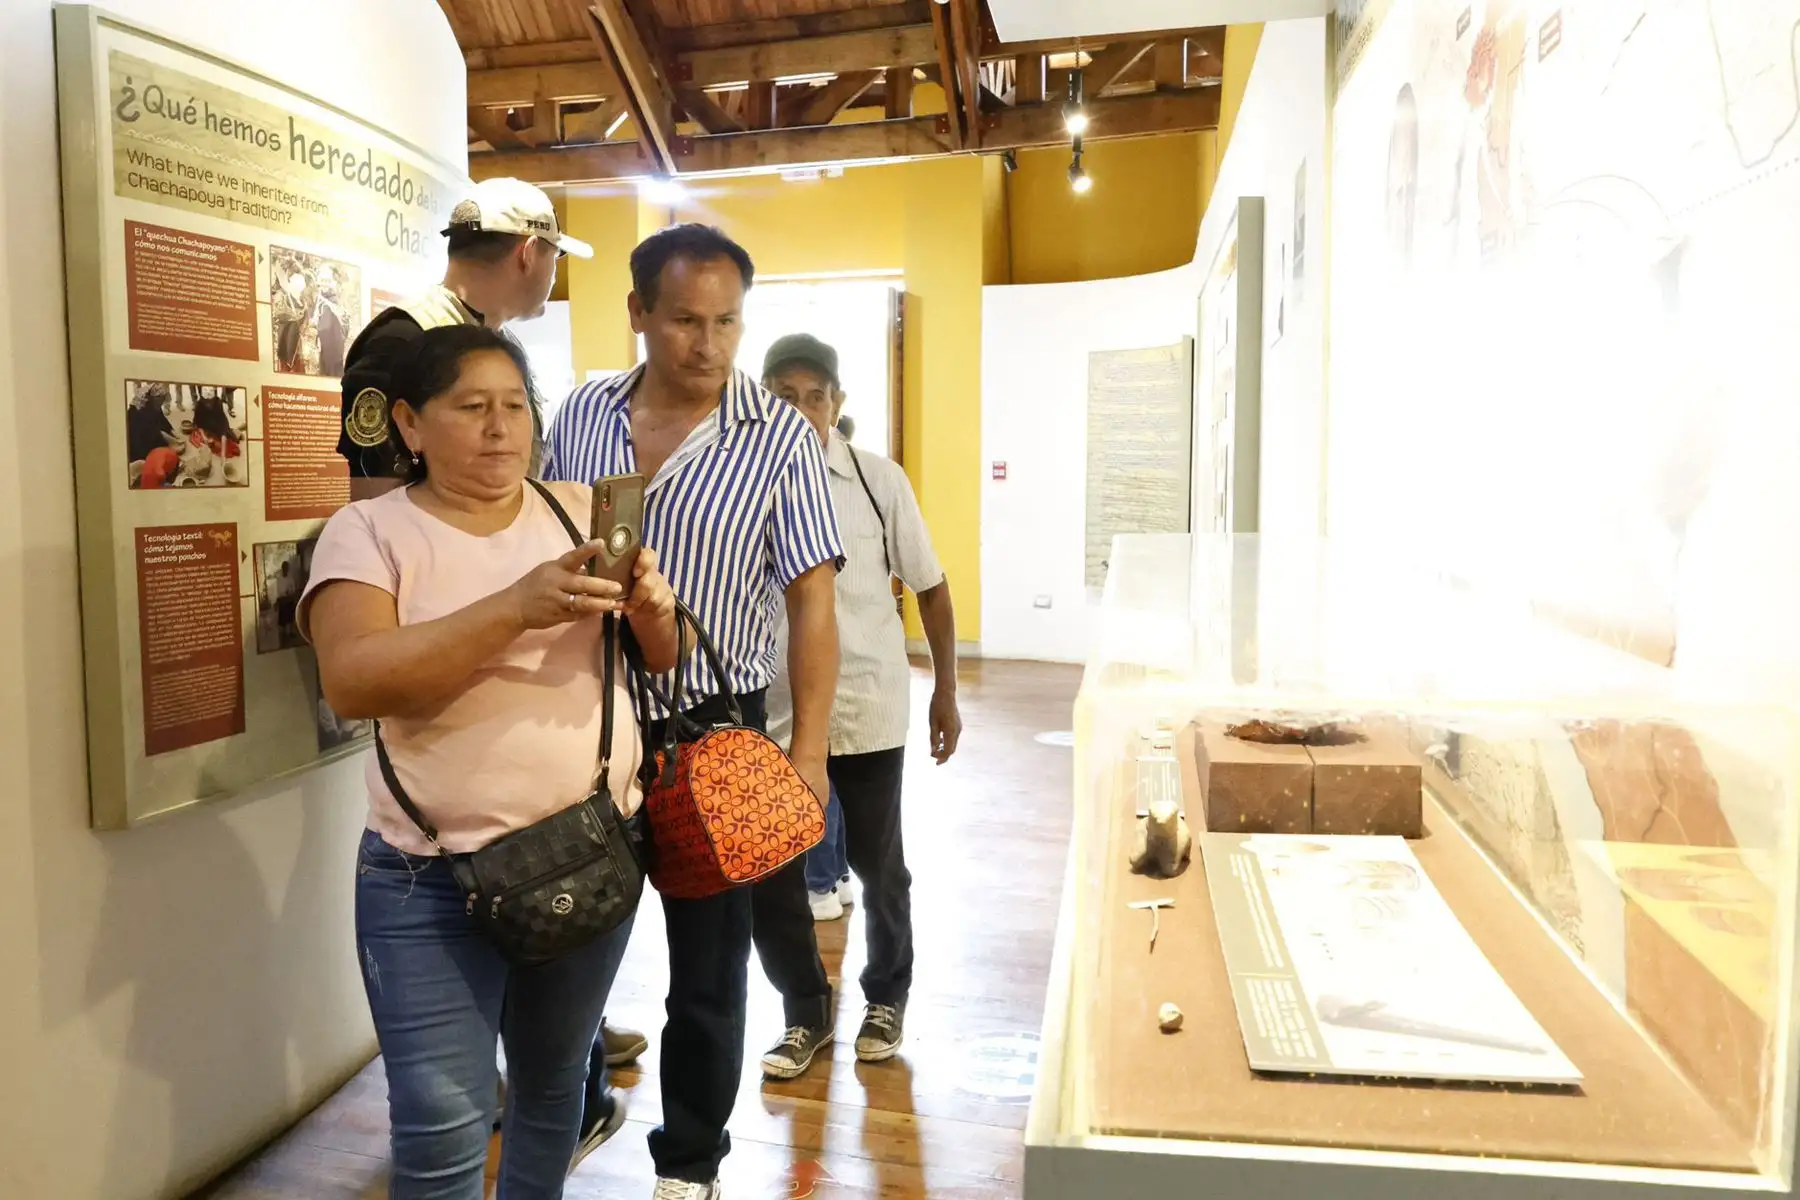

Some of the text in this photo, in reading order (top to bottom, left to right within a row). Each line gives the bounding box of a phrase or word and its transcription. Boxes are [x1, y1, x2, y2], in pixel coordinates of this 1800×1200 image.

[116, 76, 197, 125] ¿Qué
[205, 101, 281, 151] hemos
[288, 115, 414, 205] heredado
[127, 147, 329, 217] What have we inherited from
[127, 172, 292, 224] Chachapoya tradition?
[156, 244, 170, 252] nos
[170, 247, 217, 261] comunicamos
[144, 545, 164, 553] cómo
[144, 552, 207, 564] nuestros ponchos
